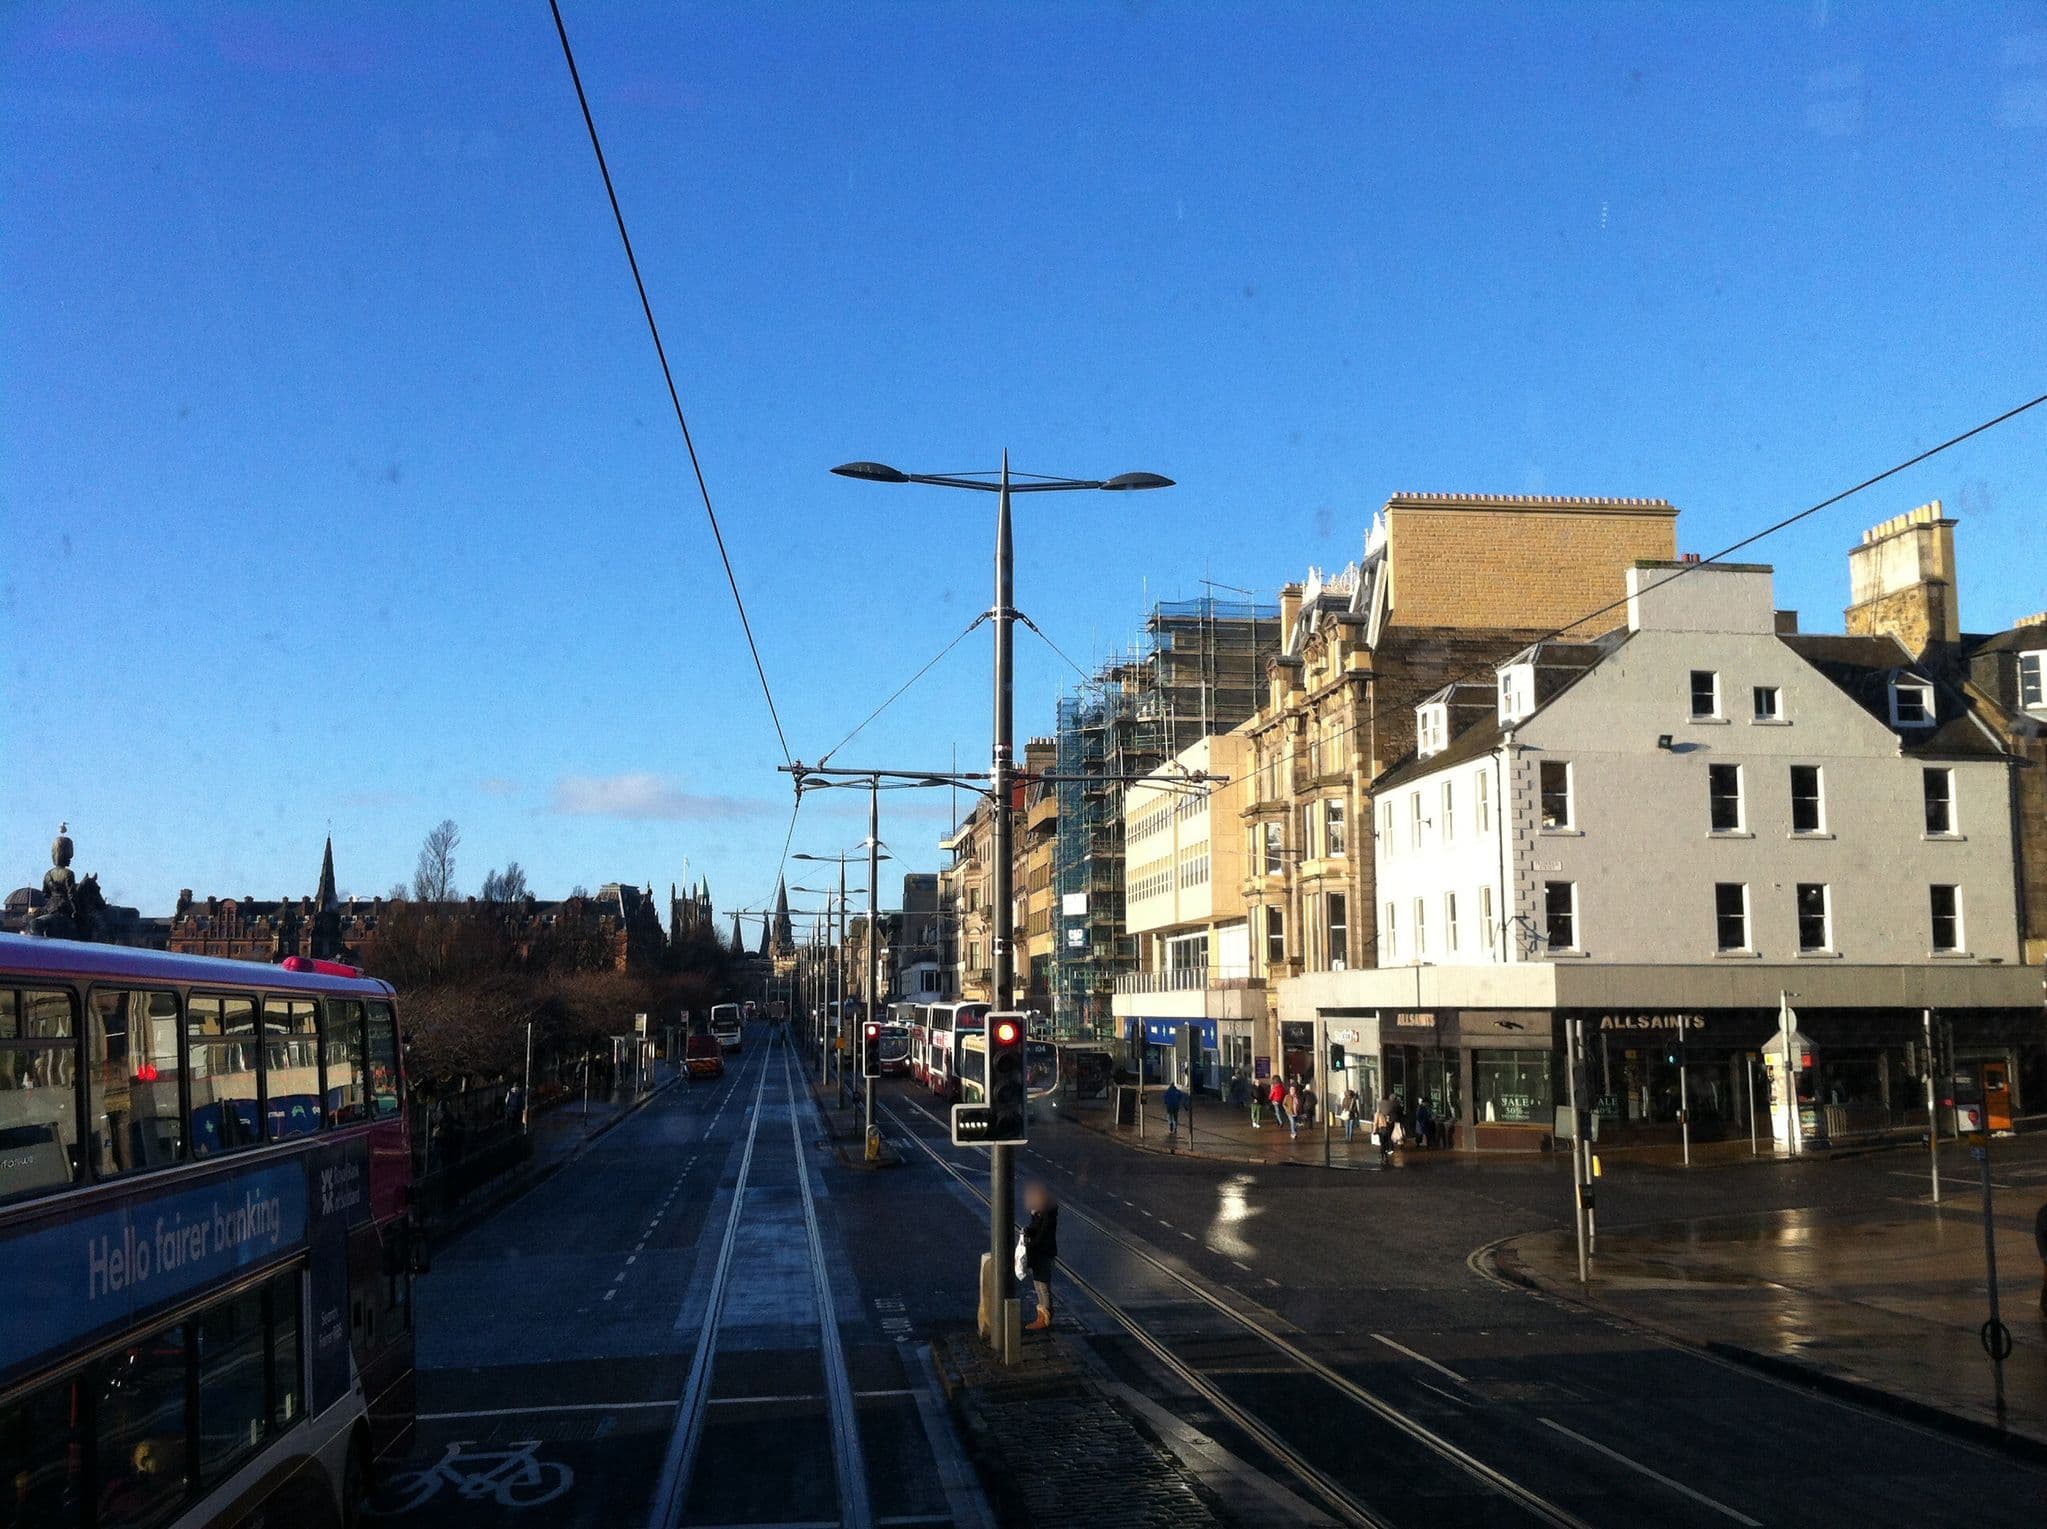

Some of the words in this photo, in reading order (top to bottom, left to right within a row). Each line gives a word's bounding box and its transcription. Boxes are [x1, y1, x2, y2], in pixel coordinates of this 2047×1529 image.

[1600, 1015, 1706, 1030] ALLSAINTS
[1501, 1096, 1529, 1107] SALE
[89, 1225, 150, 1300] Hello
[155, 1211, 210, 1274] fairer
[214, 1187, 280, 1249] banking
